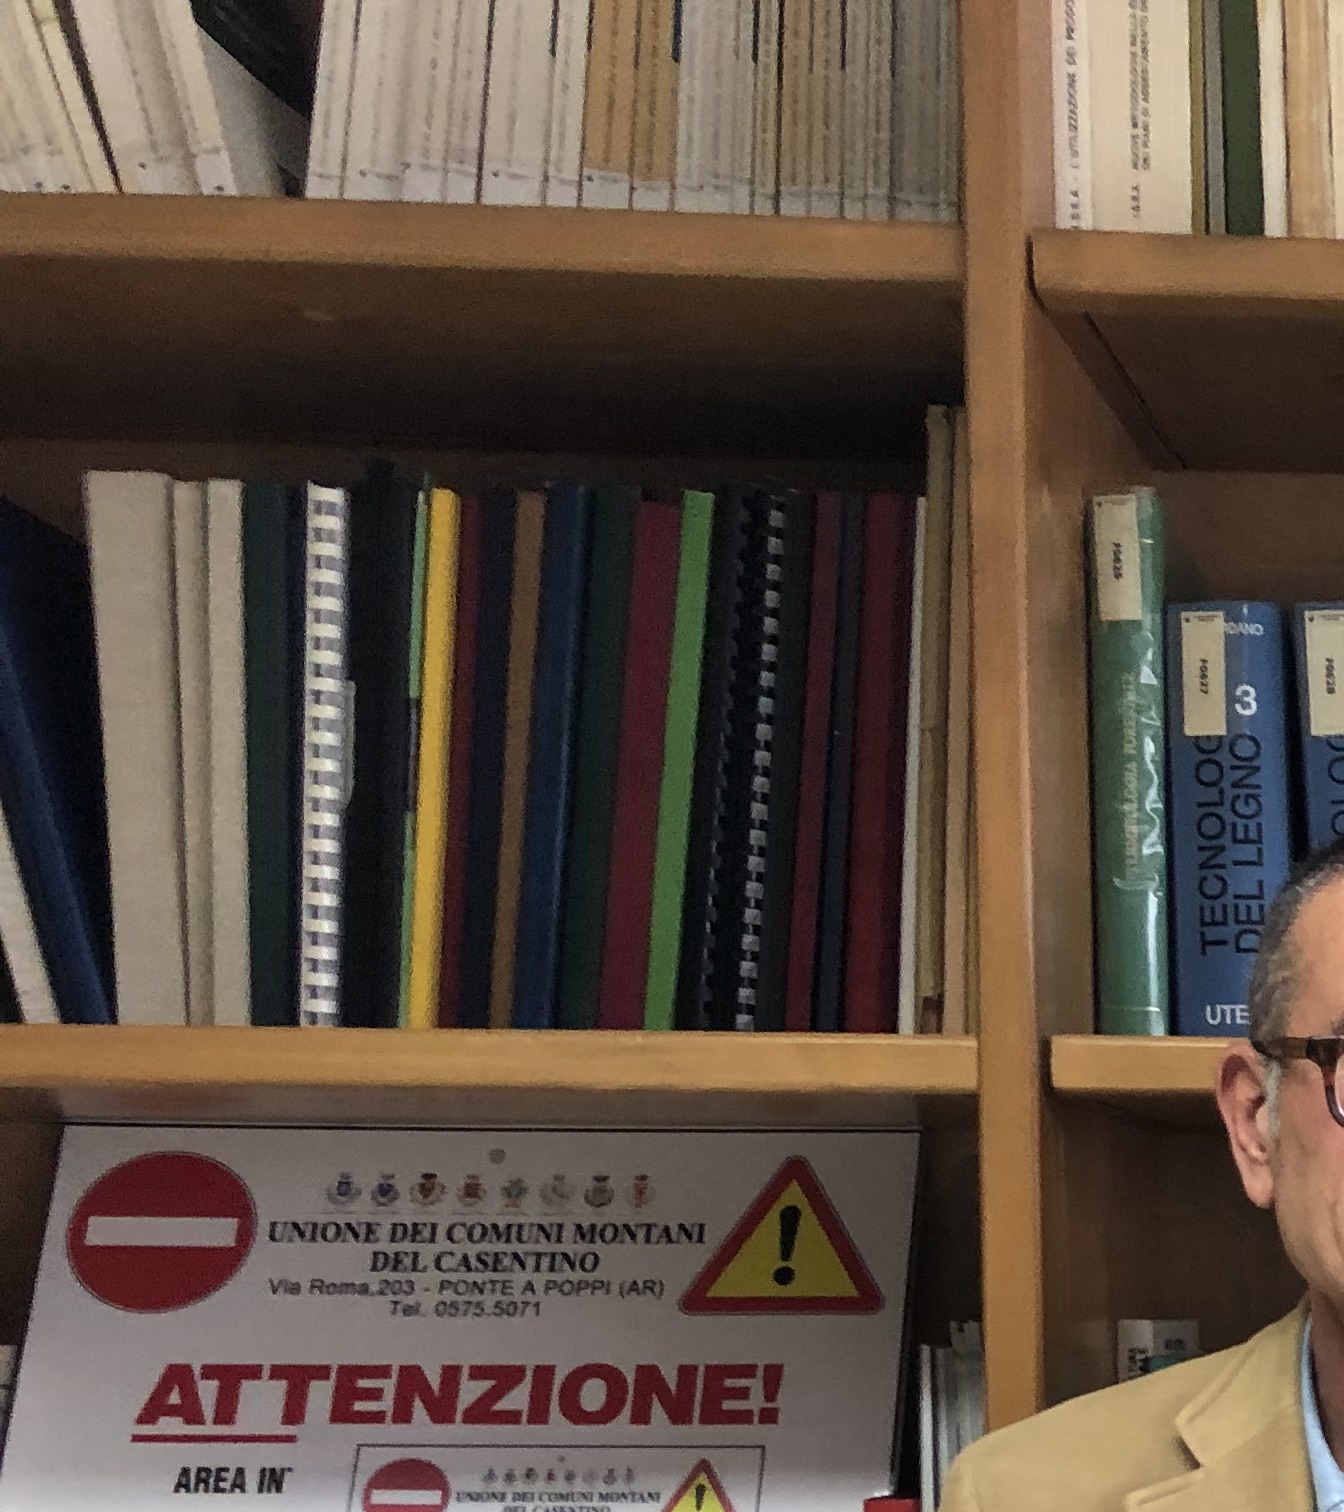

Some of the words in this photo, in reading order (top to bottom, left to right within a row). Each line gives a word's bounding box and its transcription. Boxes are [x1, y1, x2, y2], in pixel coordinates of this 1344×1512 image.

[1234, 683, 1258, 716] 3
[1228, 732, 1265, 868] LEGNO
[268, 1221, 381, 1243] UNIONE
[388, 1221, 437, 1243] DEI
[447, 1221, 564, 1244] COMUNI
[573, 1221, 707, 1245] MONTANI
[369, 1250, 427, 1274] DEL
[434, 1250, 601, 1274] CASENTINO
[268, 1278, 301, 1296] Via
[437, 1279, 514, 1297] PONTE
[522, 1280, 537, 1297] A
[544, 1279, 611, 1297] POPPI
[618, 1278, 665, 1299] (AR)
[134, 1362, 784, 1427] ATTENZIONE!
[173, 1466, 247, 1494] AREA
[257, 1466, 294, 1494] IN
